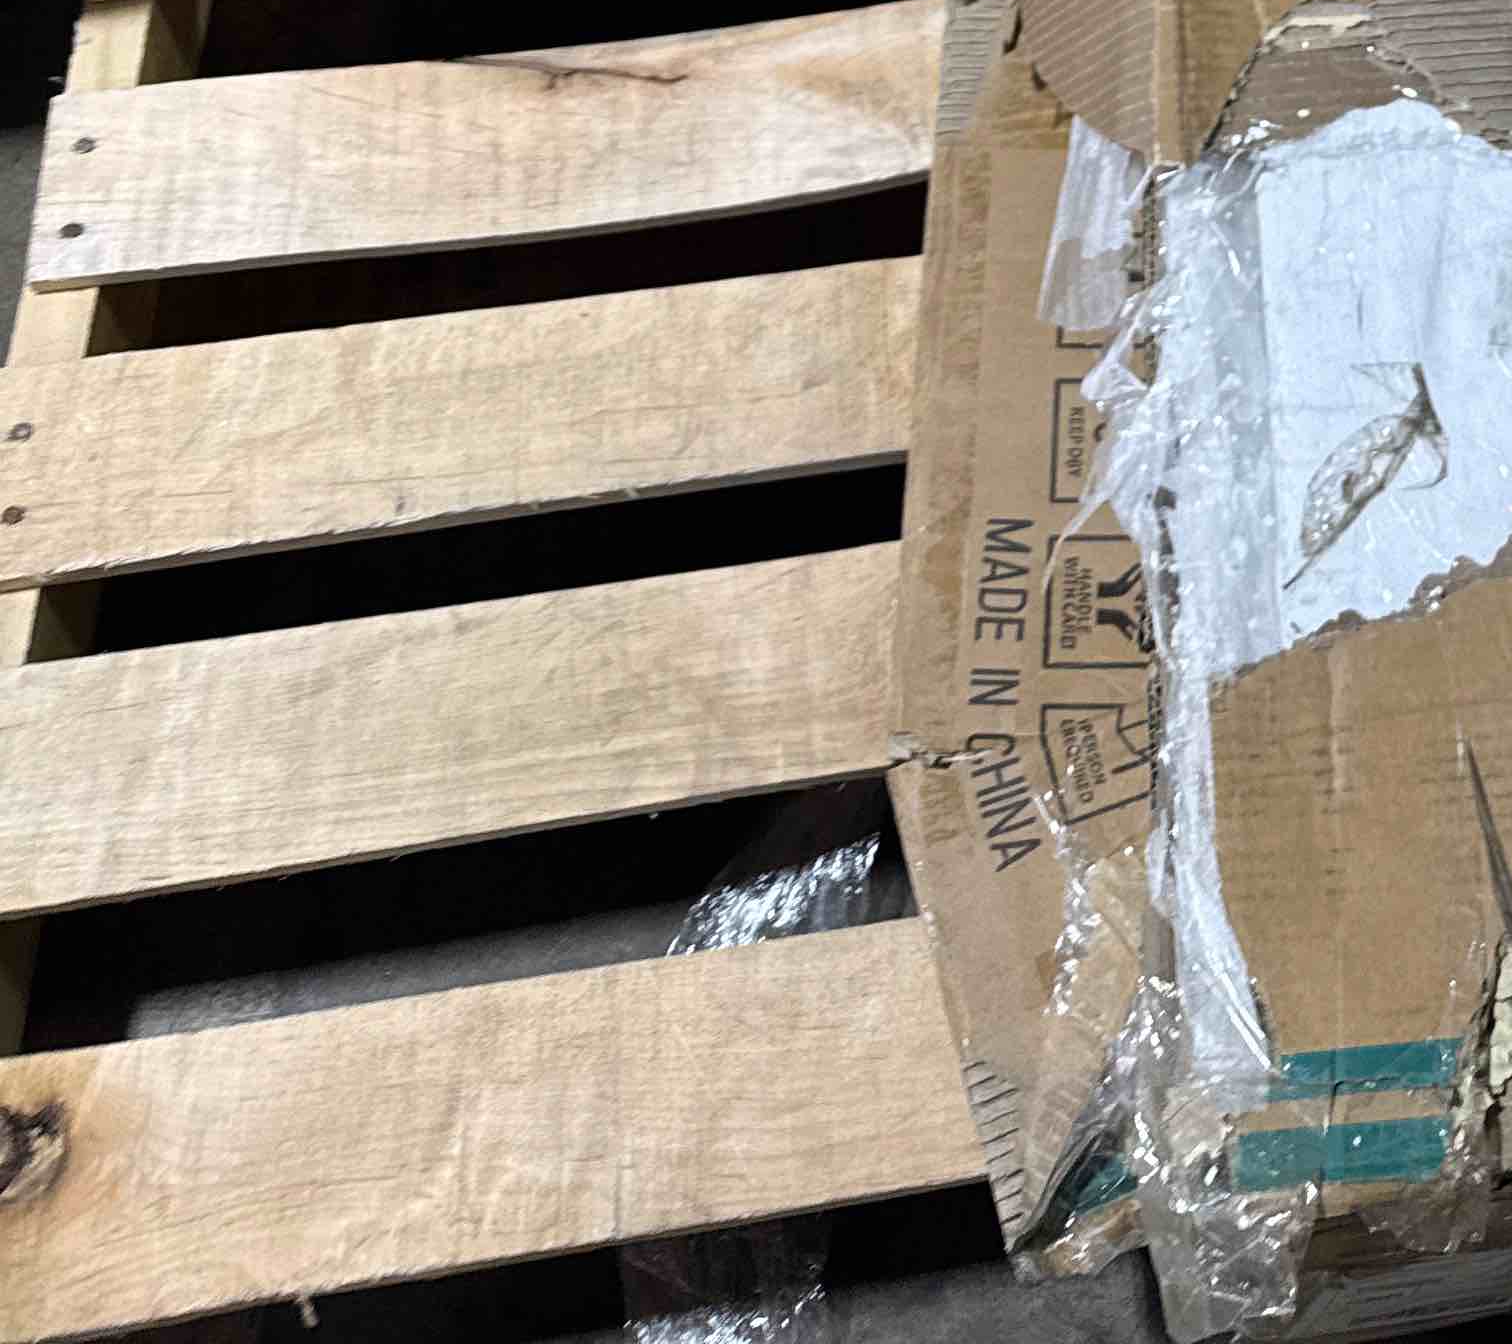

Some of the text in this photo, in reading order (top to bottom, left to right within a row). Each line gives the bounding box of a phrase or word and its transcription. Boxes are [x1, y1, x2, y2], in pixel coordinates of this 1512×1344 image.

[966, 518, 1042, 873] MADE IN CHINA
[1077, 567, 1093, 632] HANDLE
